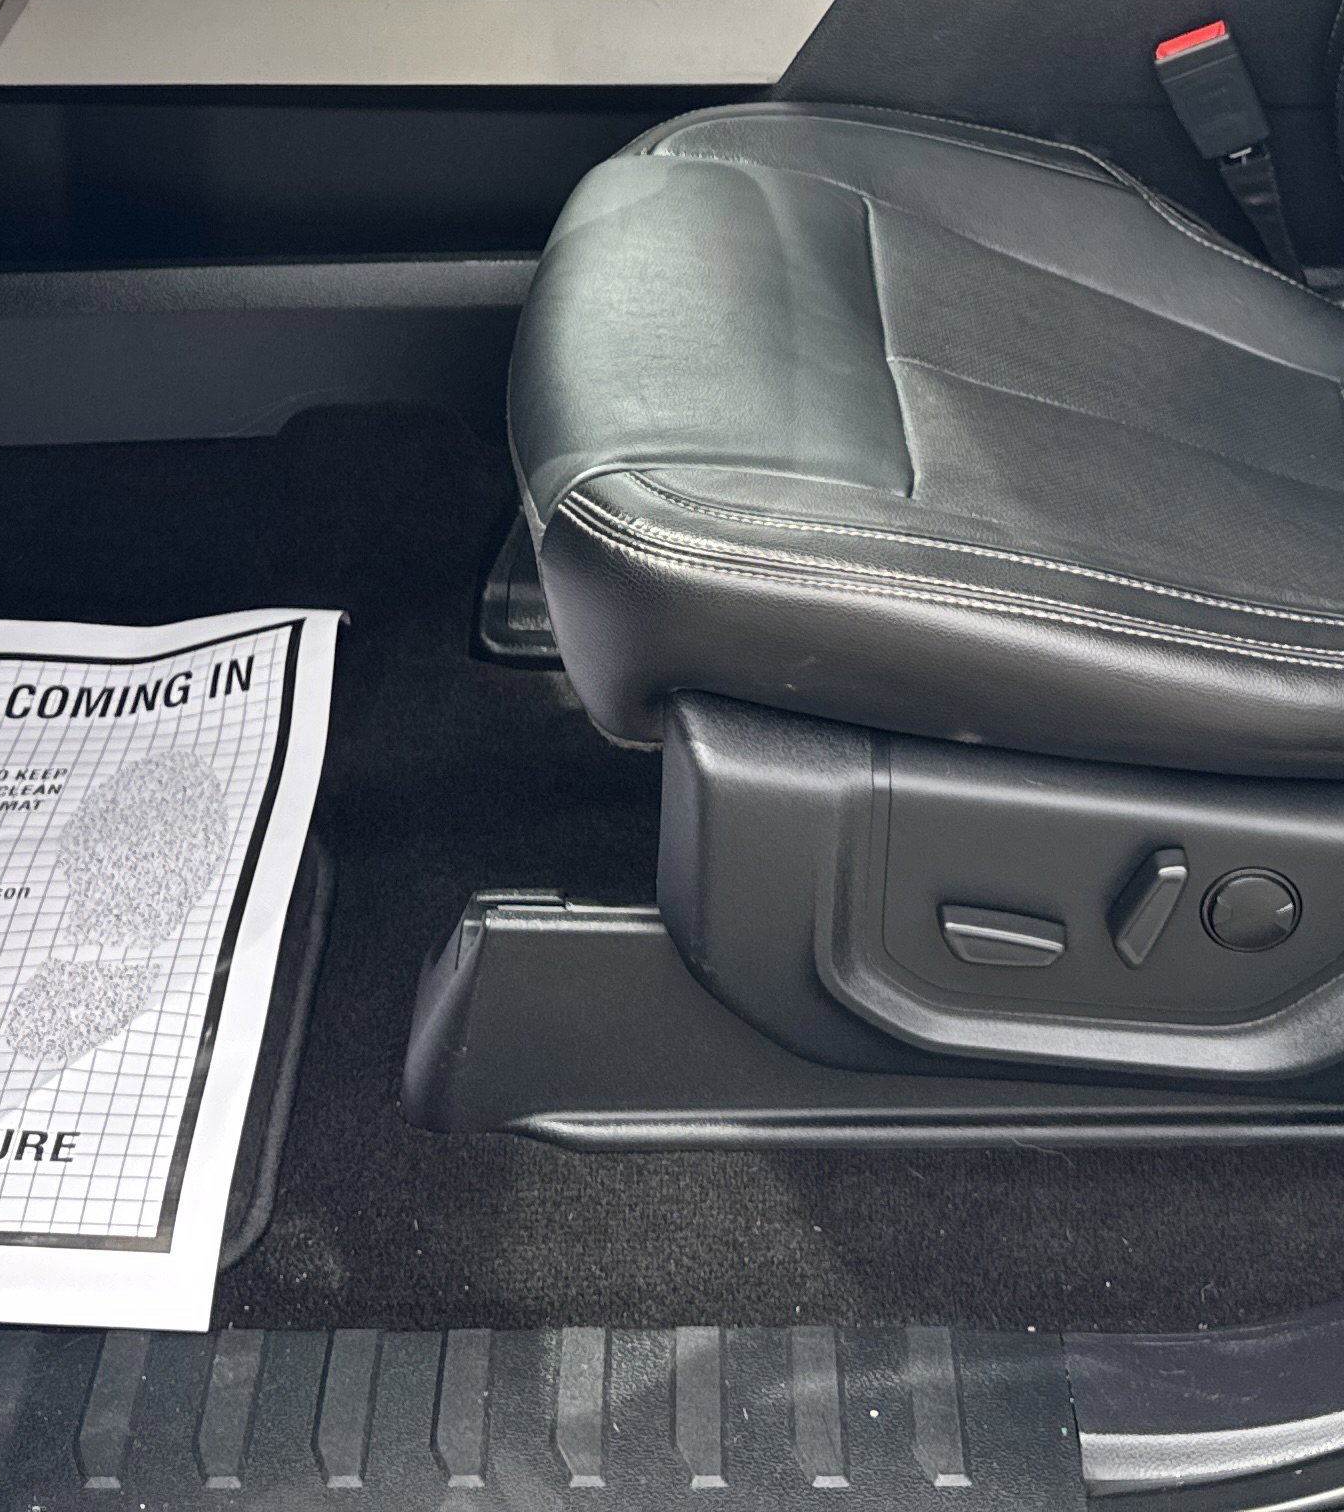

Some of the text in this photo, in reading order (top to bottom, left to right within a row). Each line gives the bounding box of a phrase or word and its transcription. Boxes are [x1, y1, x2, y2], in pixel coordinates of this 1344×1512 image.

[5, 670, 193, 719] COMING
[209, 655, 255, 699] IN
[15, 767, 68, 781] KEEP
